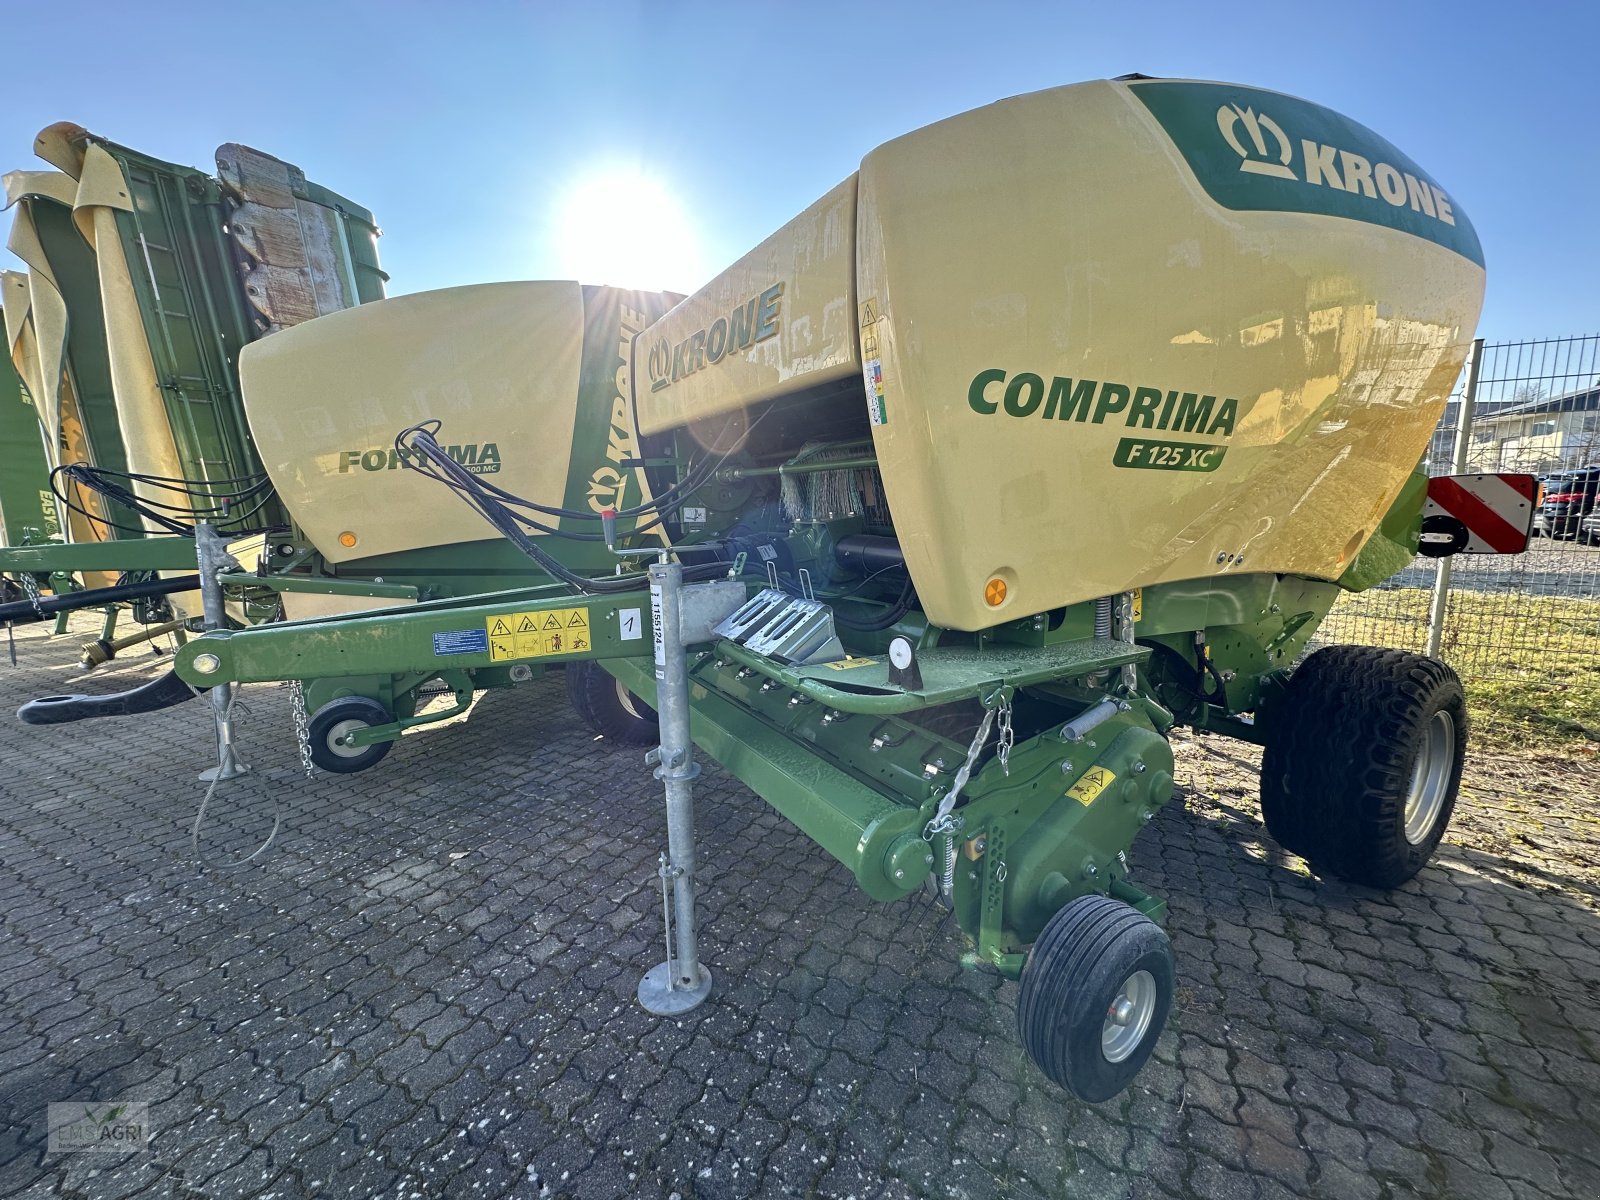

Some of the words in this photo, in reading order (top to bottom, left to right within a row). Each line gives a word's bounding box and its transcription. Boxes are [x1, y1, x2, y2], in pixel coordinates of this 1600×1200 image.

[1301, 138, 1456, 227] KRONE
[671, 280, 786, 383] KRONE
[967, 368, 1238, 437] COMPRIMA
[1126, 444, 1142, 463] F
[1148, 445, 1184, 466] 125
[1184, 448, 1215, 468] XC
[623, 616, 635, 633] 1
[653, 602, 662, 644] 1155124
